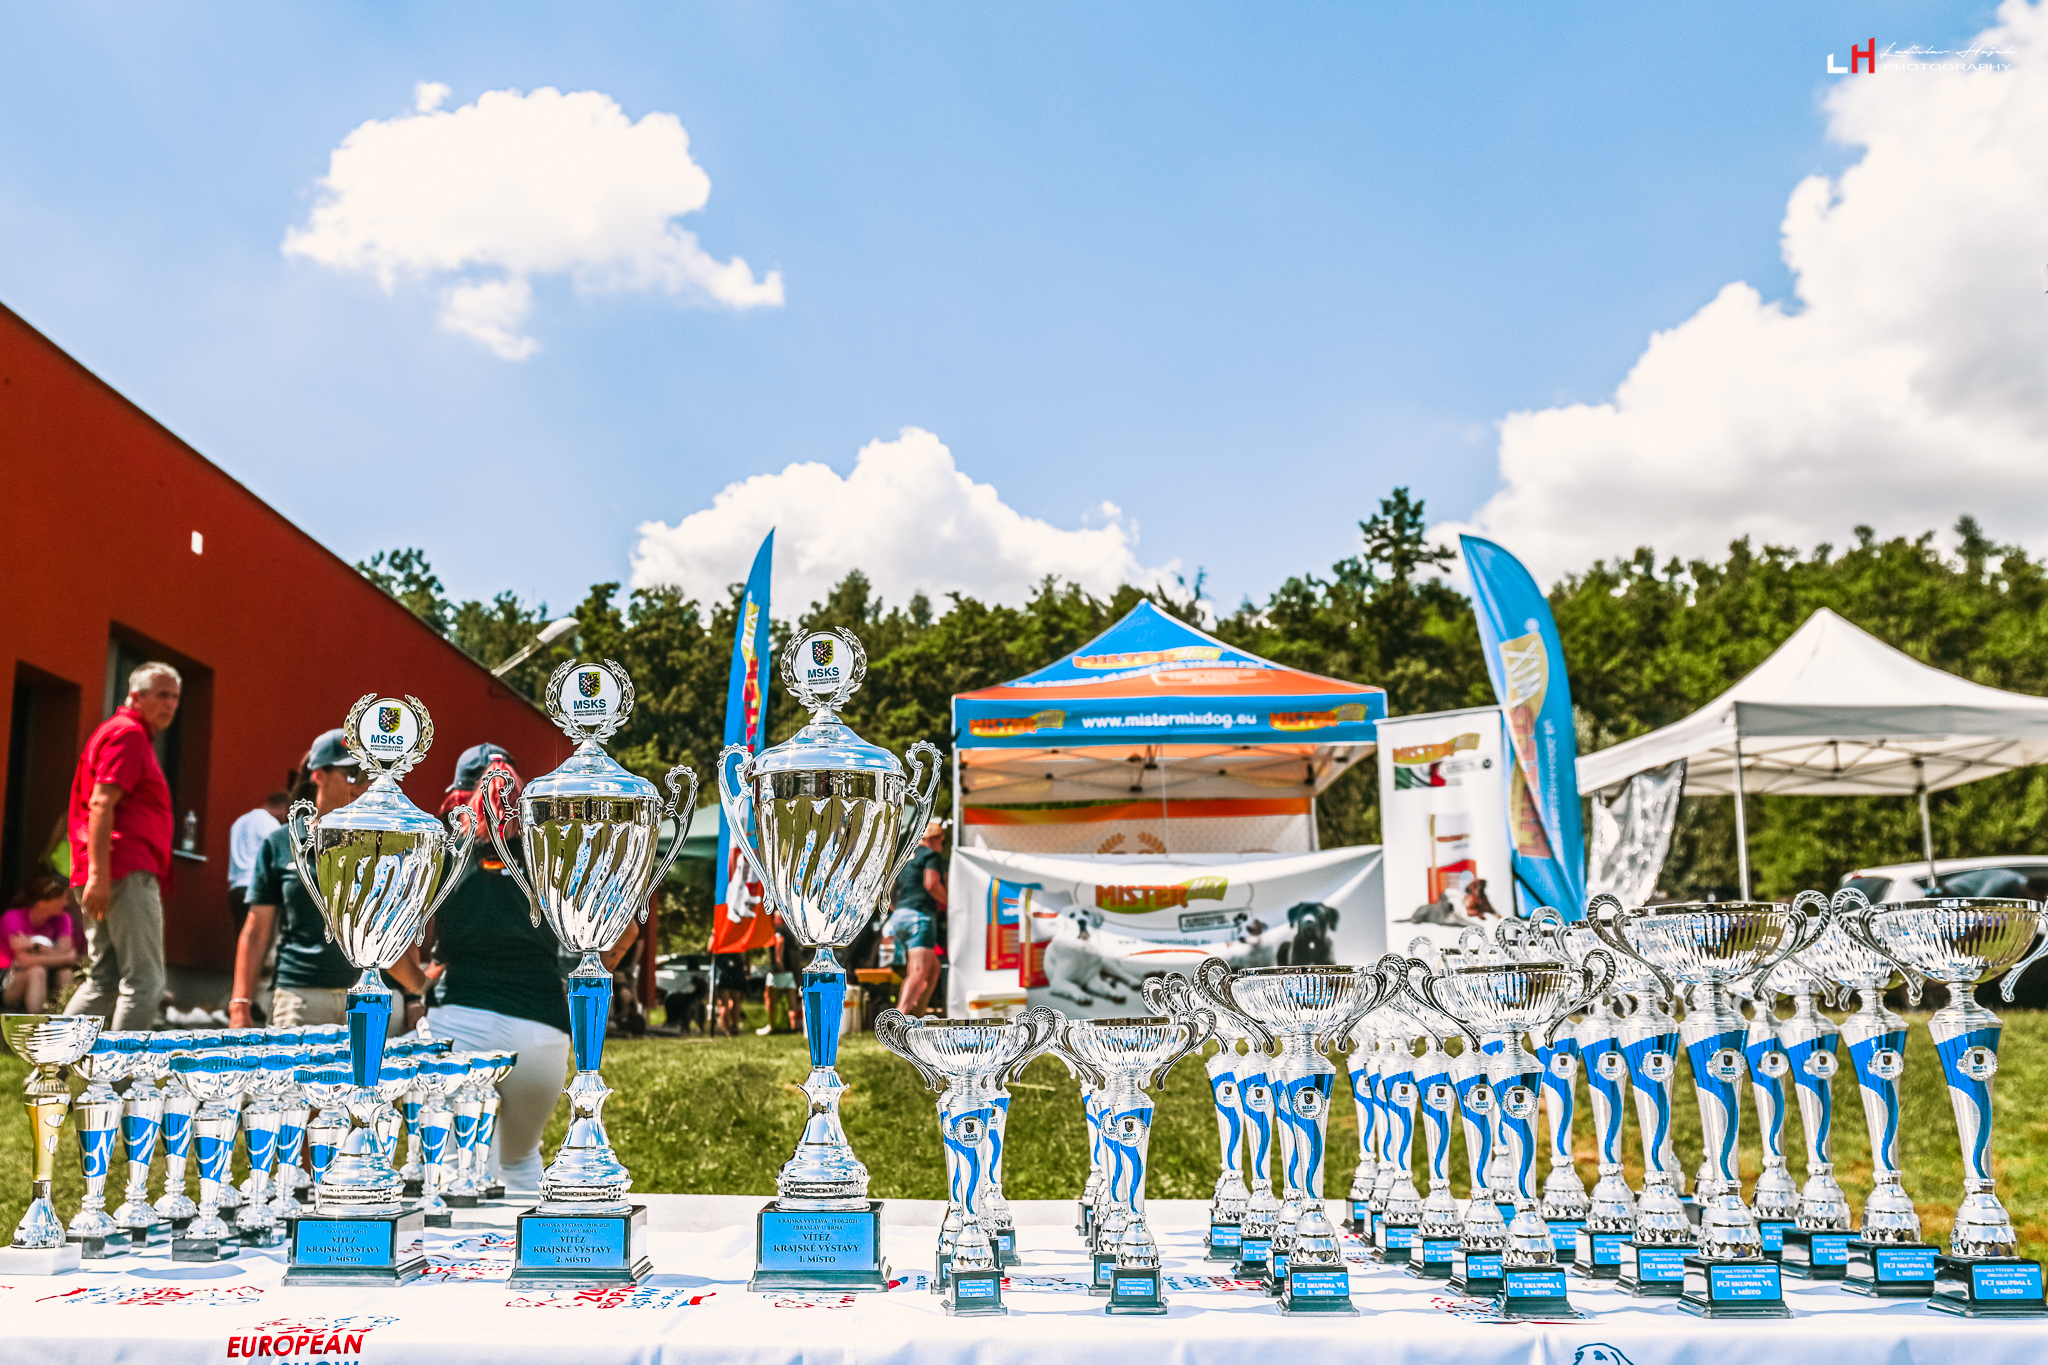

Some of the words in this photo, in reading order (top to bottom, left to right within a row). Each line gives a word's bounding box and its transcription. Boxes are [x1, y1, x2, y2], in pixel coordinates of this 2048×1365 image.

[808, 667, 839, 678] MSKS
[574, 699, 606, 709] MSKS
[1082, 711, 1257, 729] www.mistermixdog.eu
[371, 735, 403, 745] MSKS
[1096, 884, 1188, 908] MISTER
[560, 1235, 585, 1243] VÍTĚZ
[803, 1232, 830, 1240] VÍTĚZ
[533, 1244, 572, 1254] KRAJSKÉ
[574, 1244, 611, 1253] VÝSTAVY
[774, 1243, 816, 1253] KRAJSKÉ
[819, 1243, 859, 1252] VÝSTAVY
[565, 1255, 591, 1263] MÍSTO
[808, 1254, 836, 1262] MÍSTO
[227, 1334, 364, 1358] EUROPEAN
